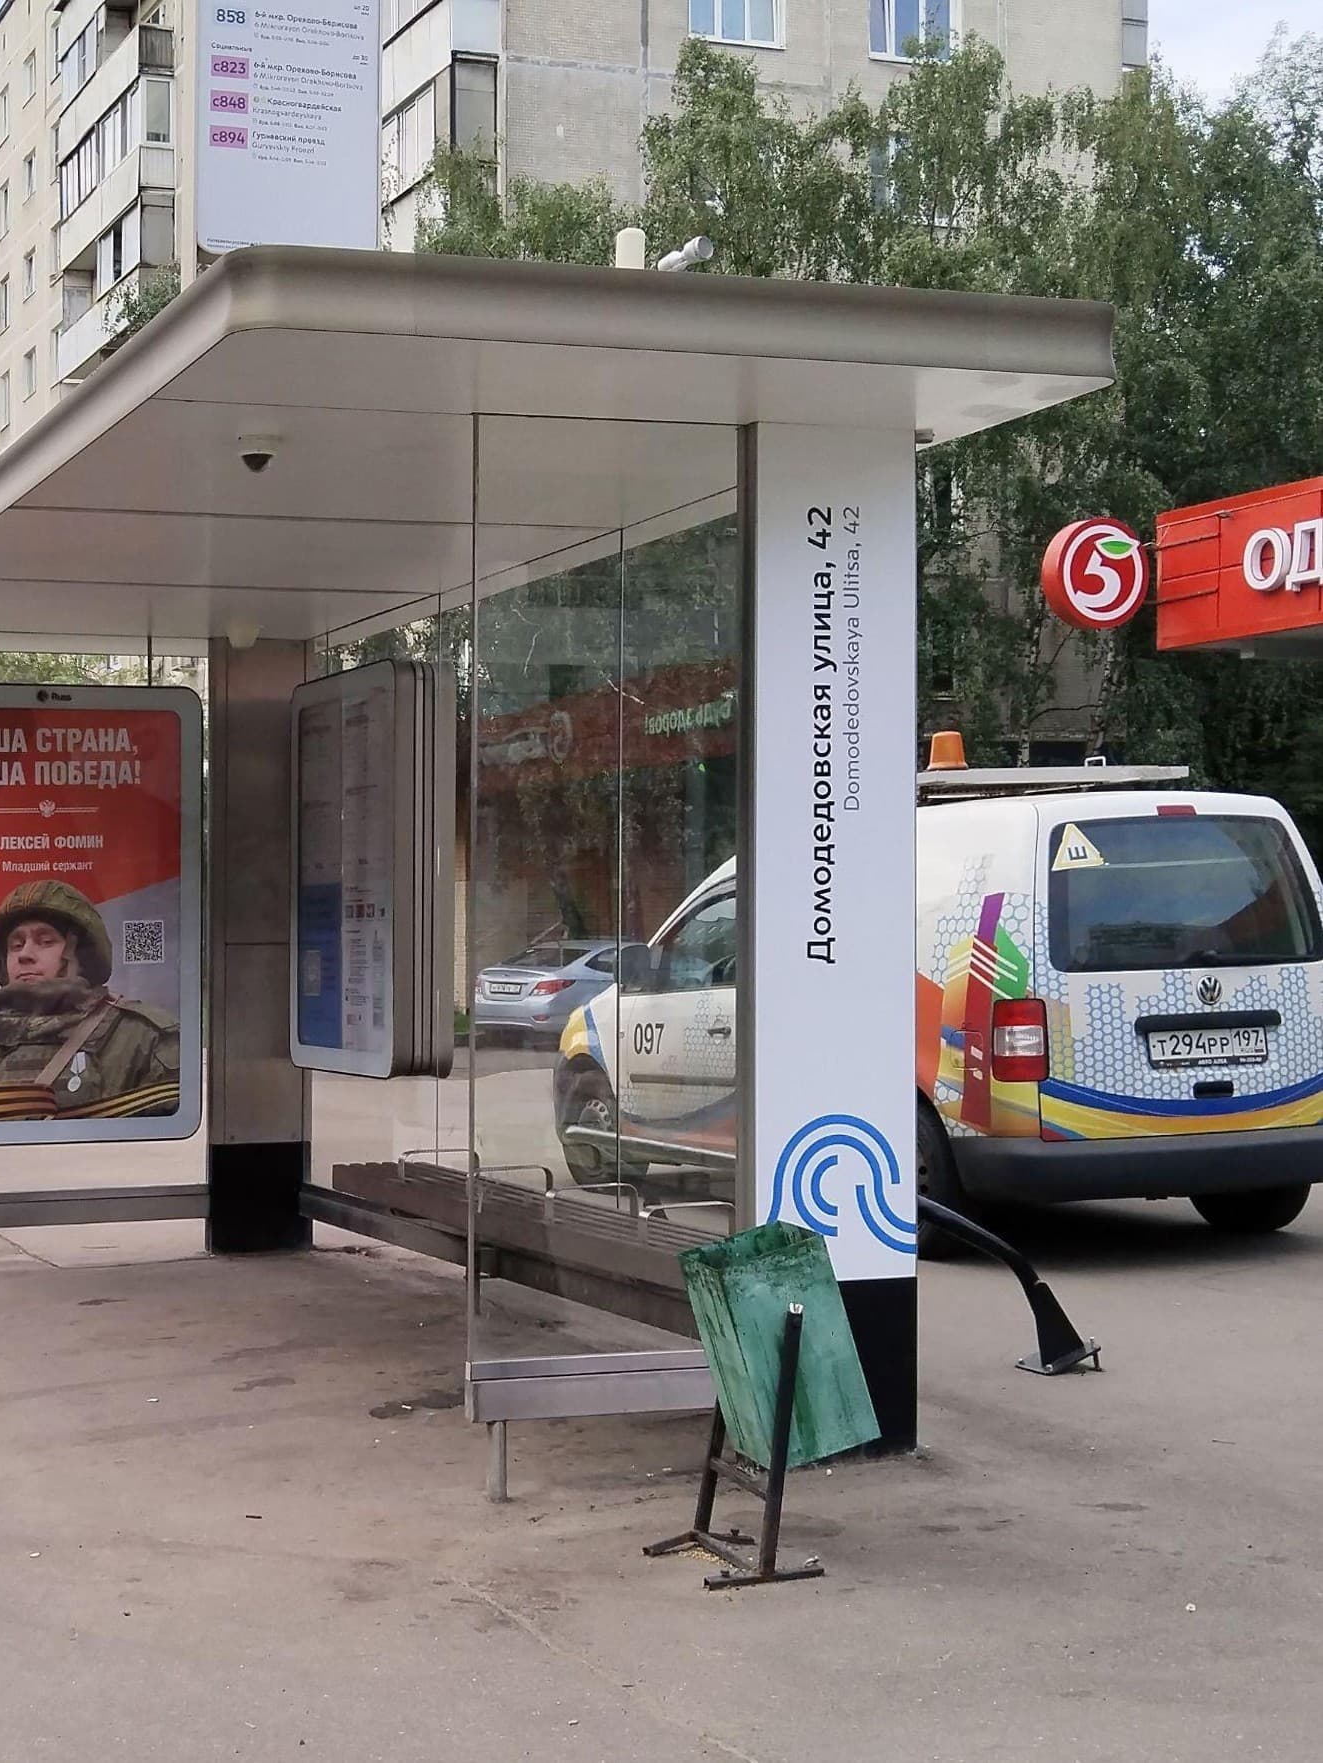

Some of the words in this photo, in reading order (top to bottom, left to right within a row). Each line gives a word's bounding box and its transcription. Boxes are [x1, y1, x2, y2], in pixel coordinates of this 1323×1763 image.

[216, 8, 246, 24] 858
[213, 61, 246, 74] с823
[212, 96, 246, 110] с848
[212, 130, 246, 144] с894
[807, 506, 832, 550] 42
[843, 506, 860, 534] 42
[843, 543, 862, 609] Ulitsa,
[813, 561, 838, 673] улица,
[842, 617, 862, 811] Domodedovskaya
[35, 728, 139, 755] СТРАНА,
[34, 760, 141, 789] ПОБЕДА!
[807, 684, 836, 964] Домодедовская
[54, 835, 104, 849] ФОМИН
[1067, 846, 1088, 861] Ш
[2, 860, 50, 873] Младший
[53, 861, 94, 873] сержант
[633, 1023, 664, 1055] 097
[1233, 1030, 1260, 1047] 197
